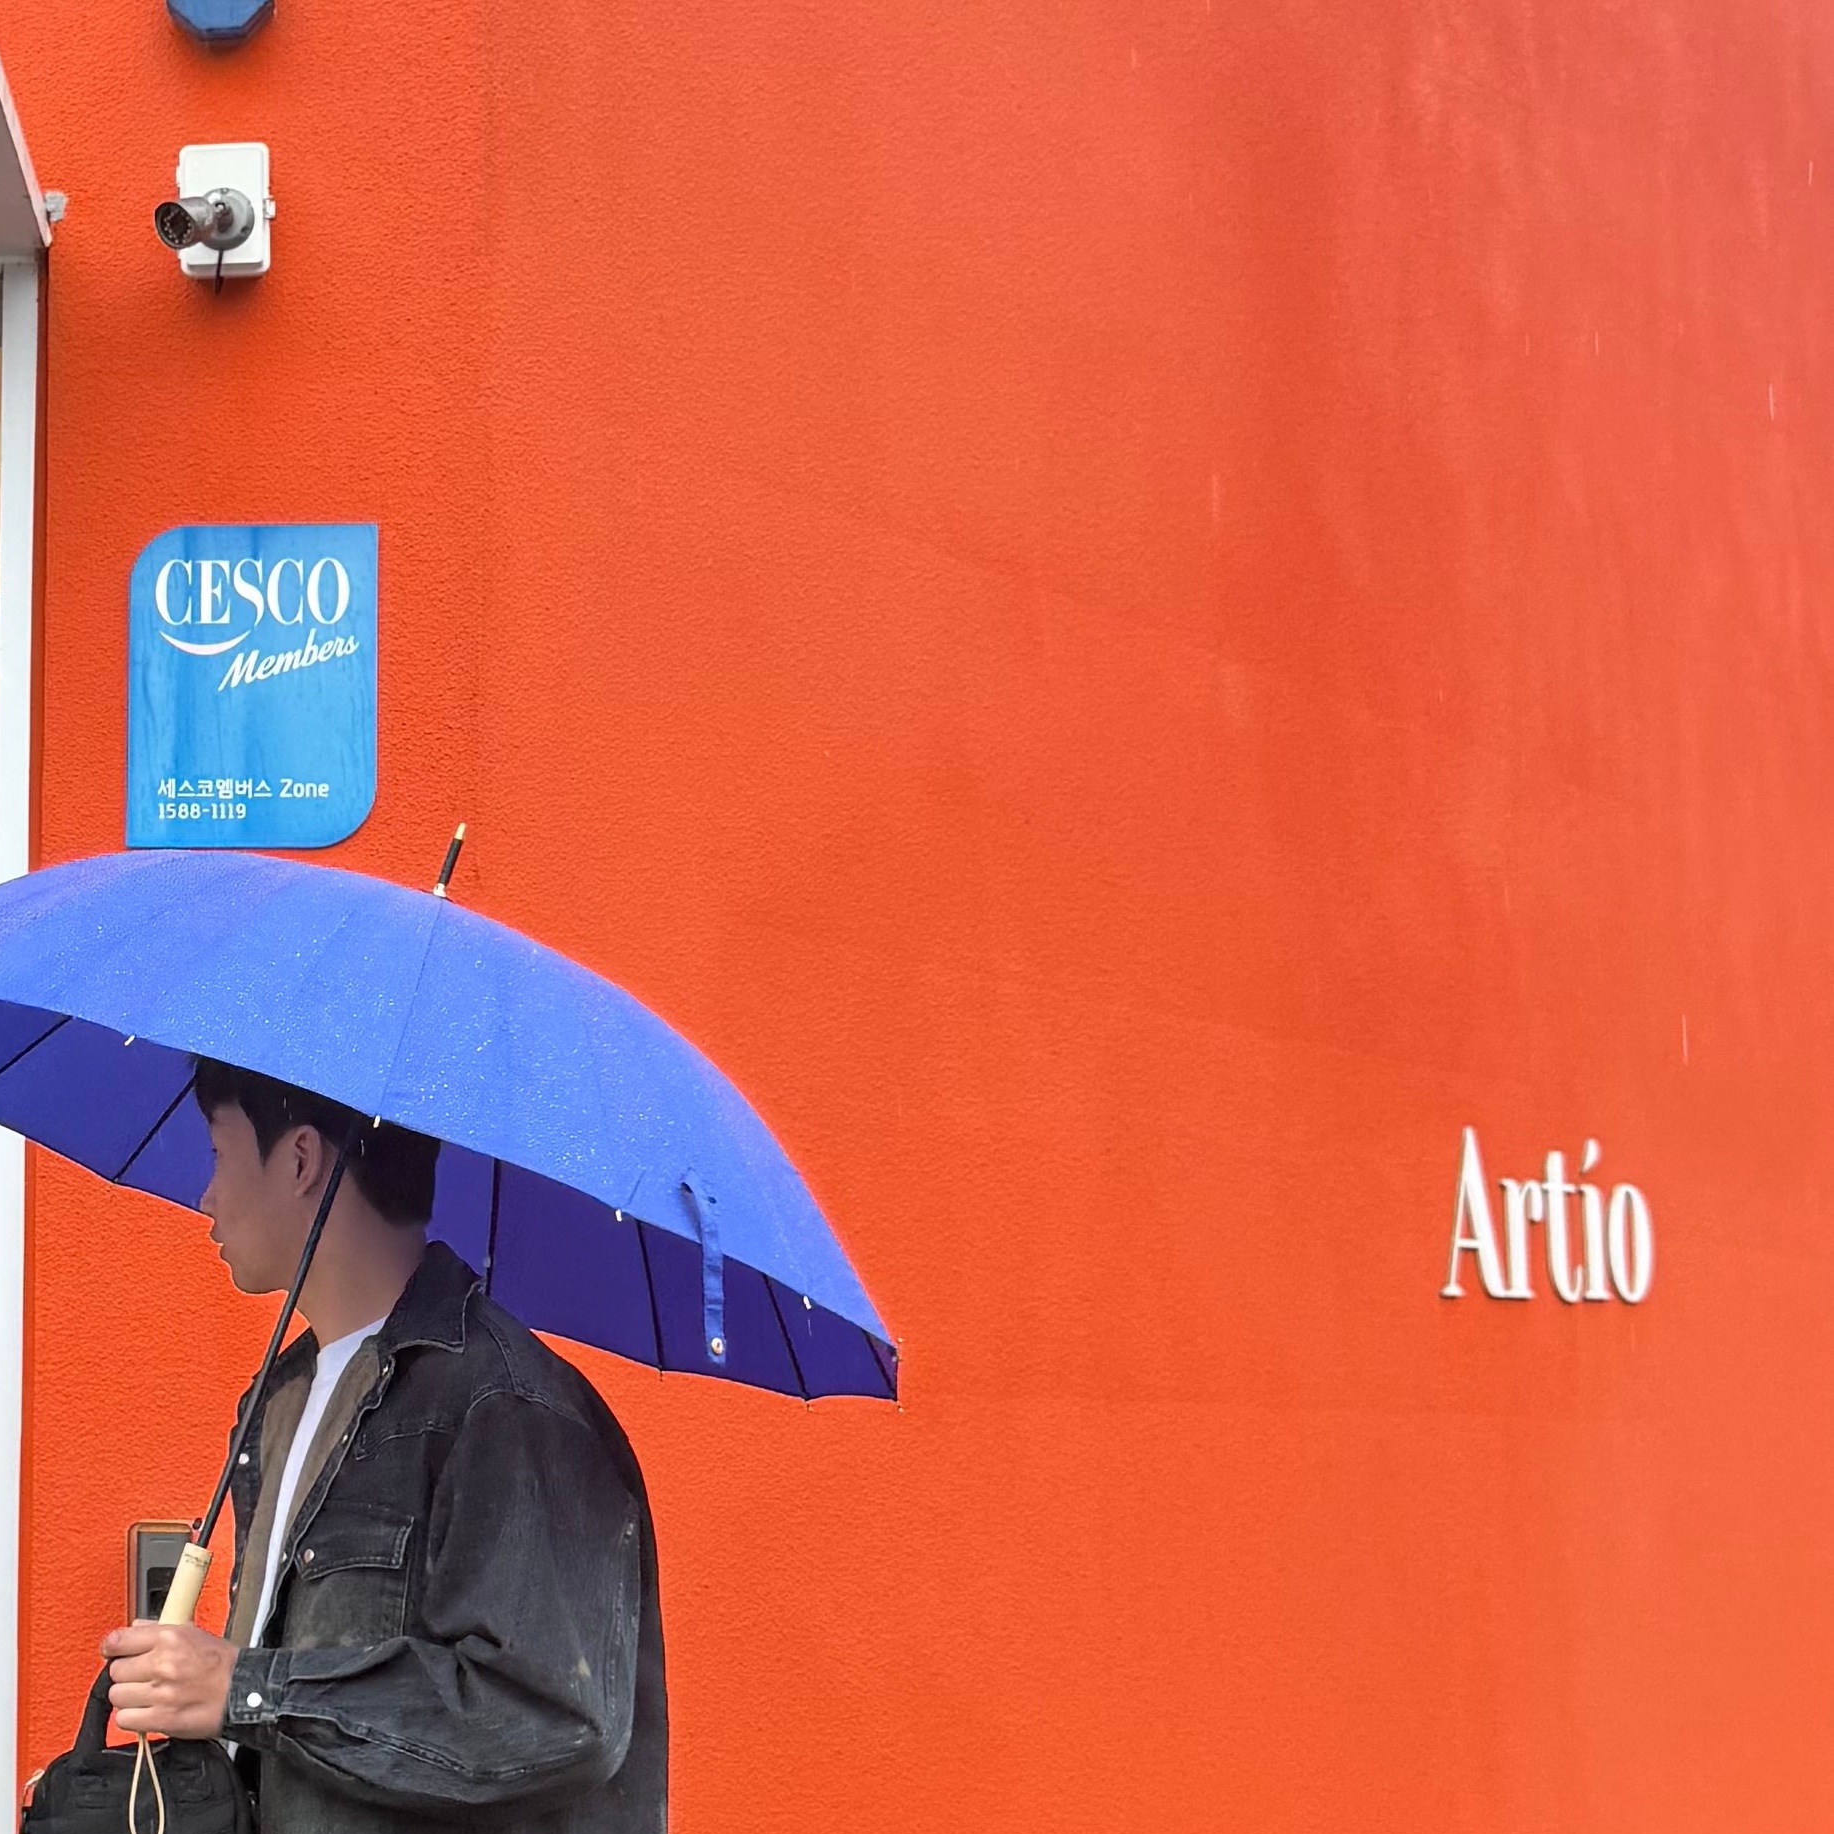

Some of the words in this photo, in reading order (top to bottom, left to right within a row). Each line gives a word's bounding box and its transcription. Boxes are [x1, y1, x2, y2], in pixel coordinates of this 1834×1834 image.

[155, 557, 351, 627] CESCO
[216, 627, 360, 692] Members
[157, 778, 273, 800] 세스코멤버스
[279, 778, 330, 799] Zone
[157, 802, 247, 820] 1588-1119
